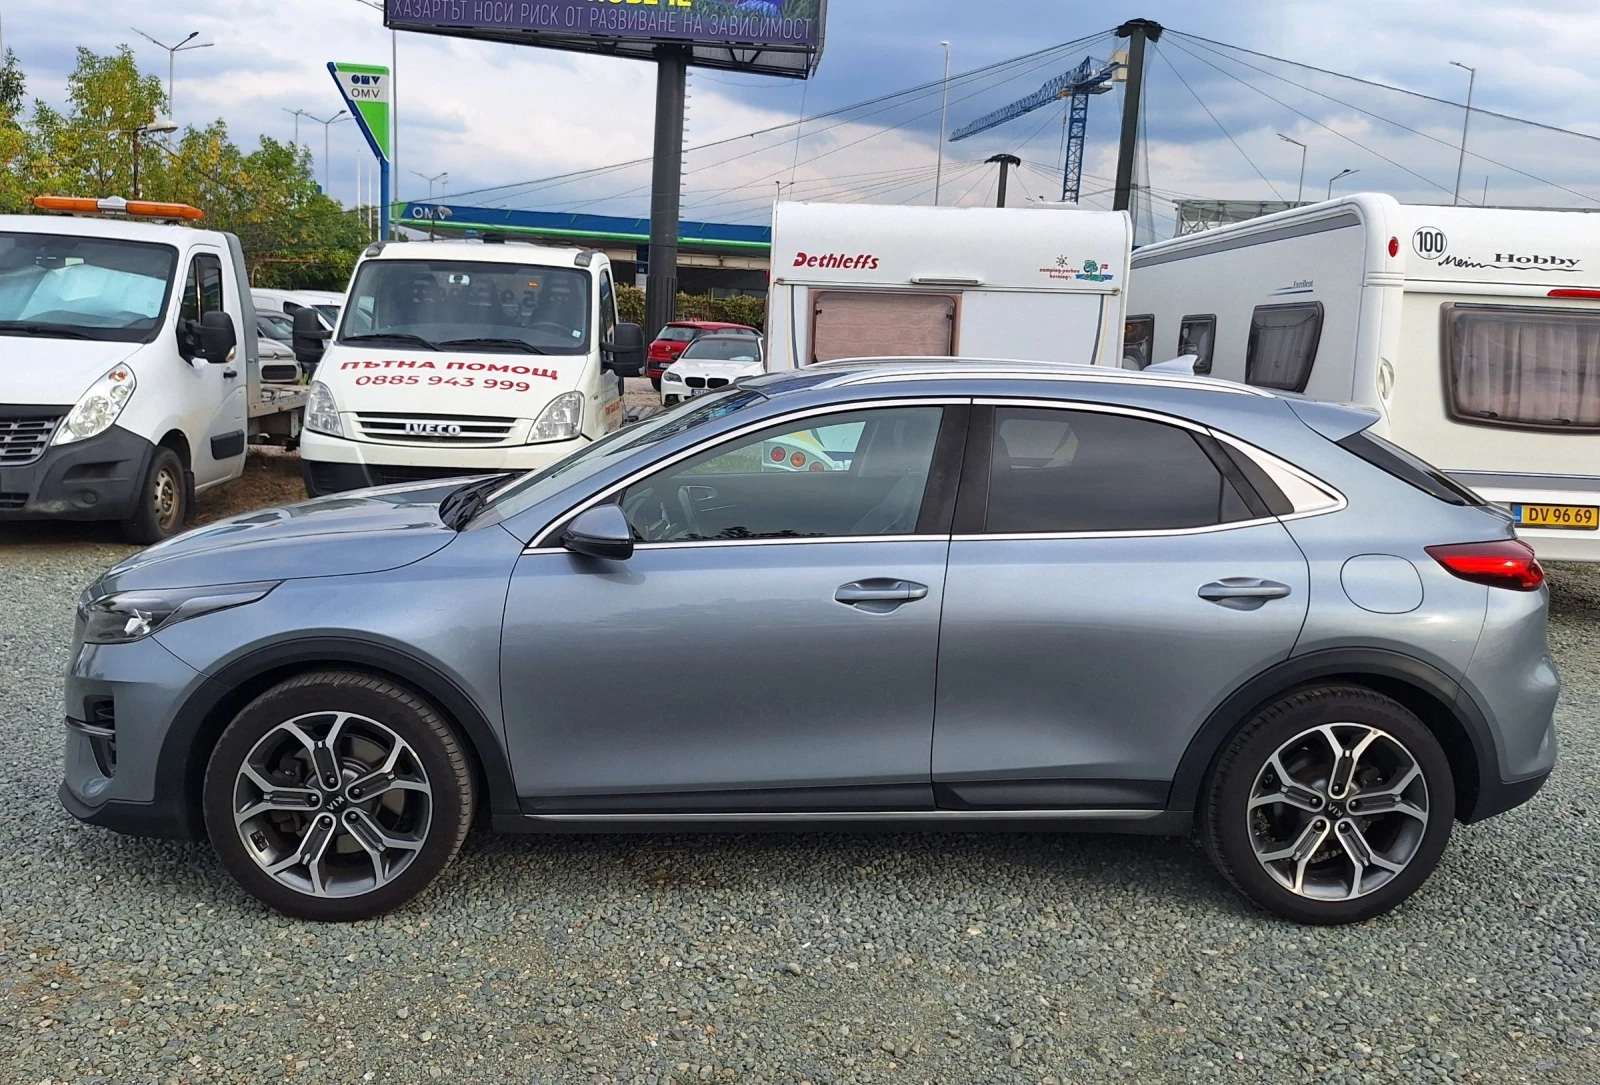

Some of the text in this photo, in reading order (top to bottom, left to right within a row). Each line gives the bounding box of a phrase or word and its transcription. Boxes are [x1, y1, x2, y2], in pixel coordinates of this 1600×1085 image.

[393, 0, 812, 39] ХАЗАРТЪТ НОСИ РИСК ОТ РАЗВИВАНЕ НА ЗАВИСИМОСТ
[351, 88, 380, 99] OMV
[1416, 231, 1444, 254] 100
[792, 252, 880, 270] Dethleffs
[1438, 253, 1581, 268] Mein Hobby
[340, 360, 558, 380] ПЪТНА ПОМОЩ
[355, 375, 531, 392] 0885 943 999
[404, 423, 462, 436] IVECO
[1528, 507, 1592, 524] DV 96 69
[325, 795, 345, 811] KIA
[1328, 802, 1344, 818] KIA
